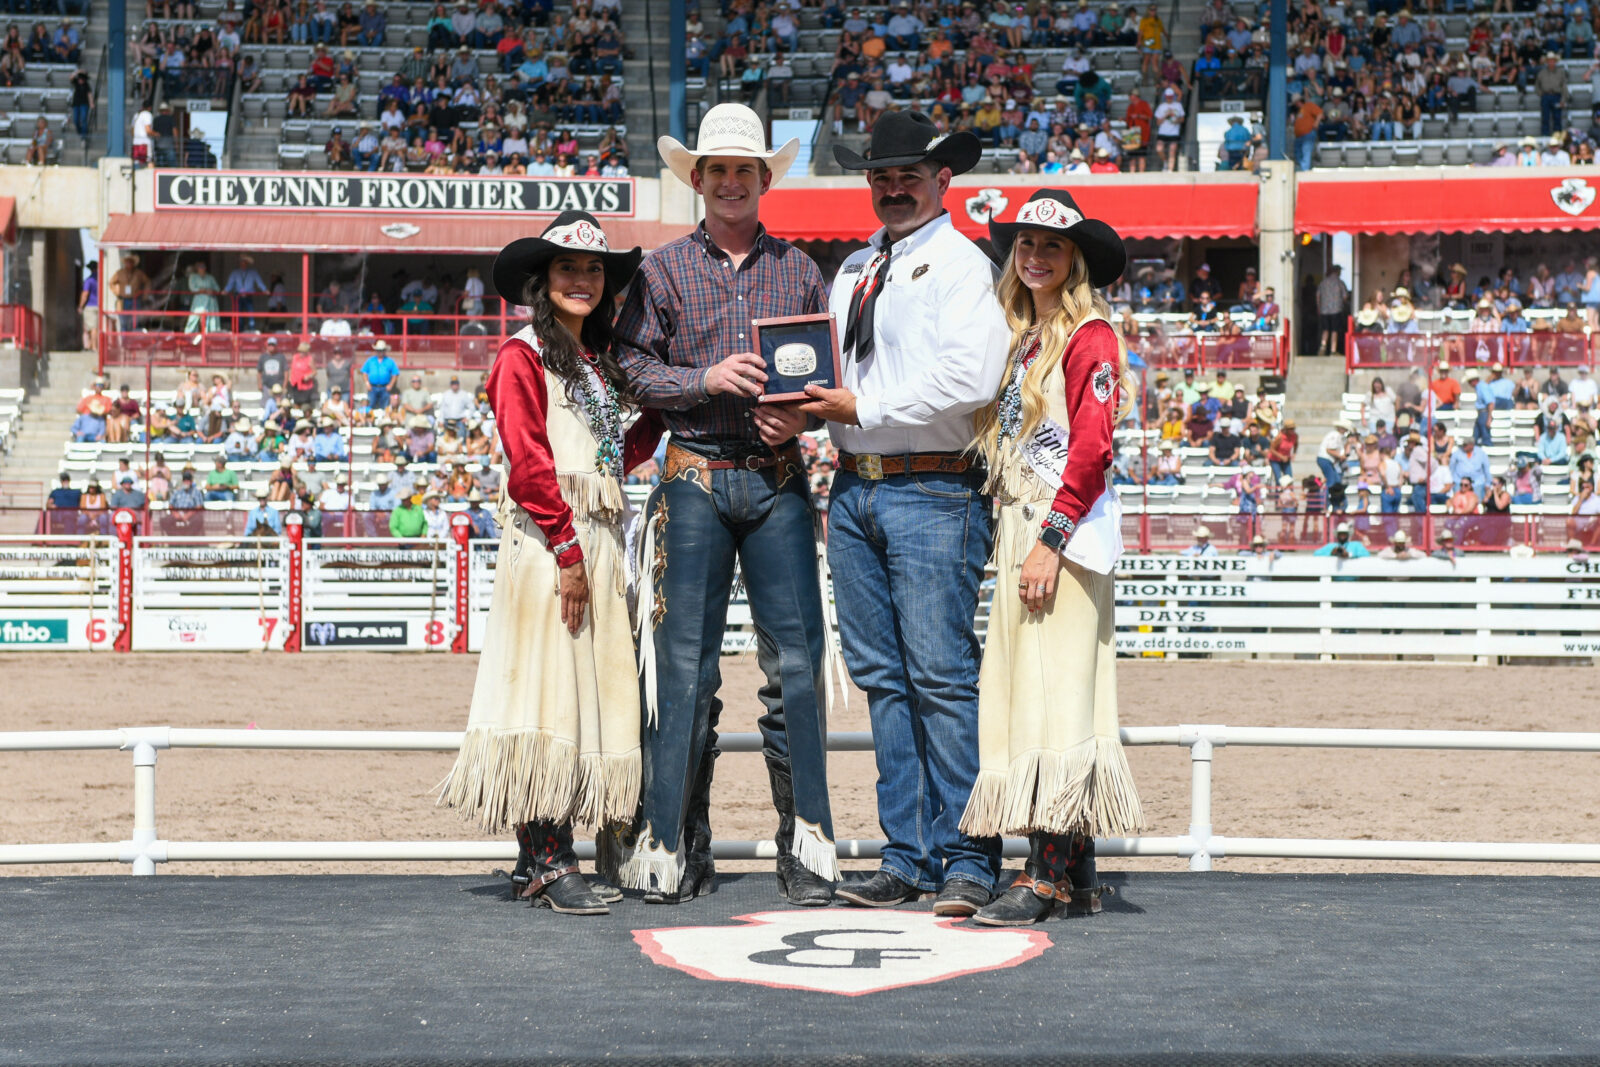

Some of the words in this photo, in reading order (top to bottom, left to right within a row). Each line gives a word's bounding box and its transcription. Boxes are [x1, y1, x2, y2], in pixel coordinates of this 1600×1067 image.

[169, 175, 350, 206] CHEYENNE
[360, 178, 526, 210] FRONTIER
[537, 182, 619, 212] DAYS
[1033, 424, 1069, 460] ting
[366, 552, 413, 562] FRONTIER
[1139, 611, 1205, 622] DAYS
[2, 621, 51, 642] fnbo
[86, 619, 106, 643] 6
[258, 618, 278, 642] 7
[338, 626, 403, 638] RAM
[424, 620, 445, 645] 8
[1115, 638, 1246, 649] ww.cfdrodeo.com
